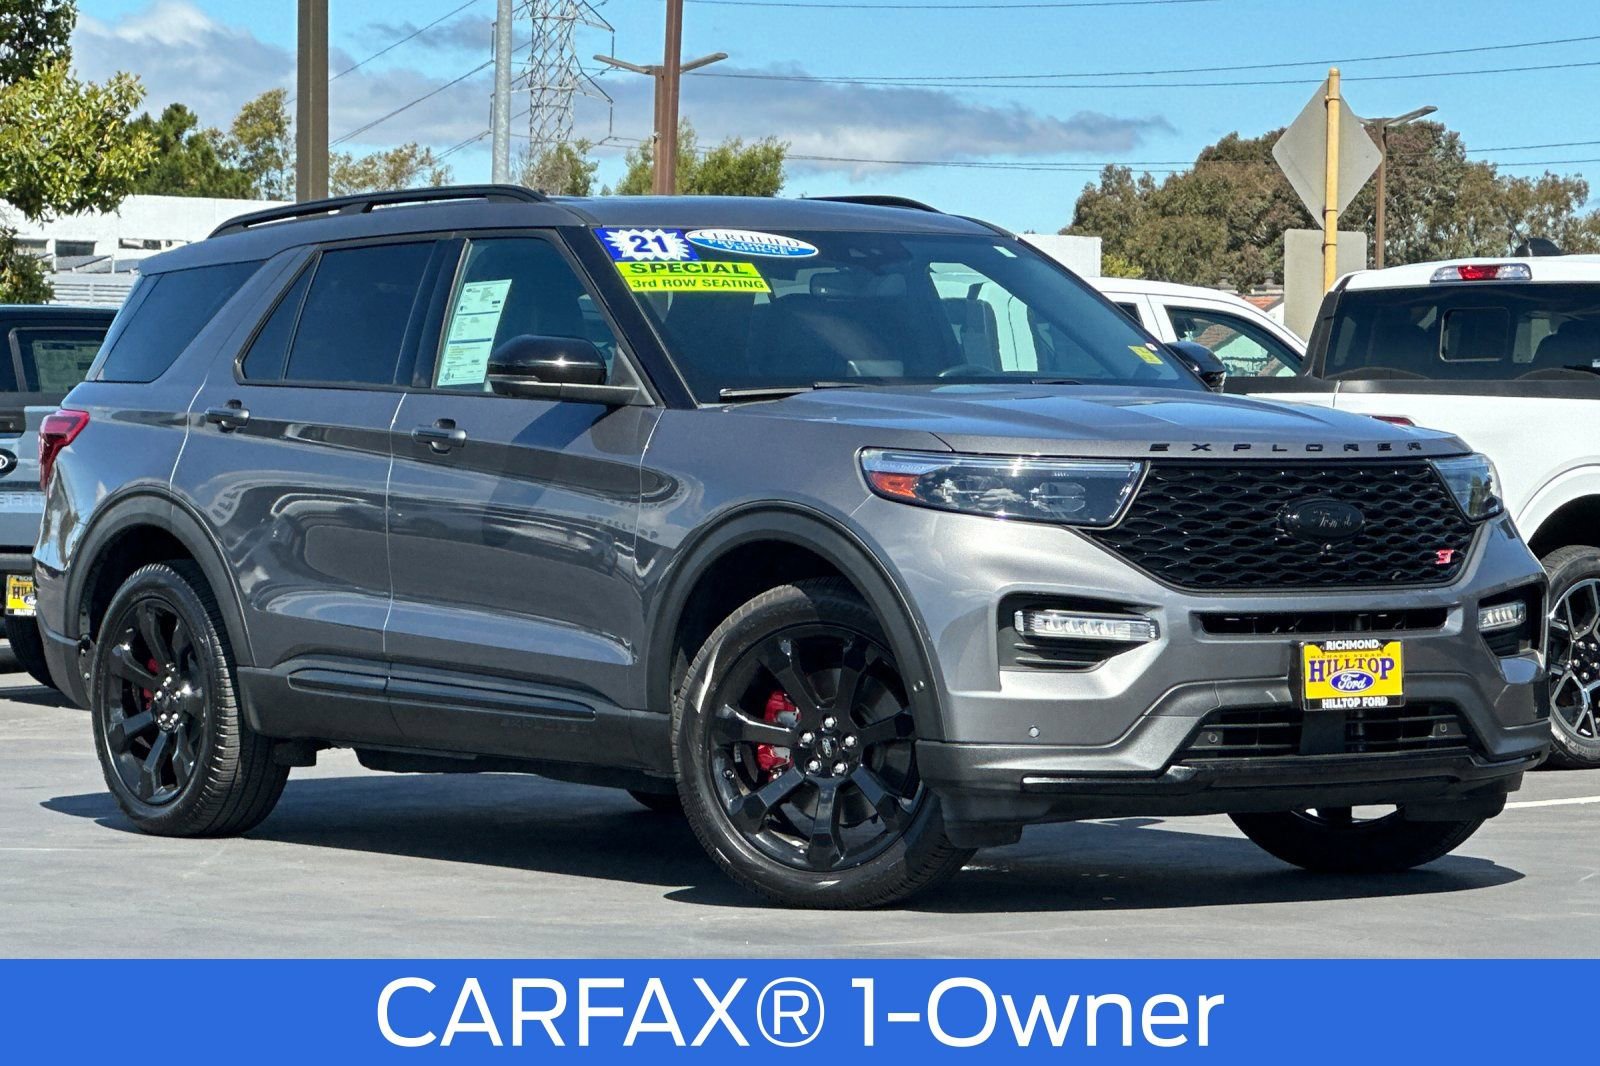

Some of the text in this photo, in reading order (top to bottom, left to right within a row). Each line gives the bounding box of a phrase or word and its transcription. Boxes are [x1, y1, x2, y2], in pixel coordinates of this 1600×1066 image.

[629, 234, 668, 254] 21
[699, 231, 800, 247] CERTIFIED
[630, 262, 749, 276] SPECIAL
[632, 278, 765, 289] 3rd ROW SEATING
[1149, 442, 1422, 453] EXPLORER
[1326, 639, 1380, 651] RICHMOND
[1308, 657, 1395, 683] HILLTOP
[1337, 673, 1367, 690] Ford
[1322, 696, 1388, 709] HILLTOP FORD
